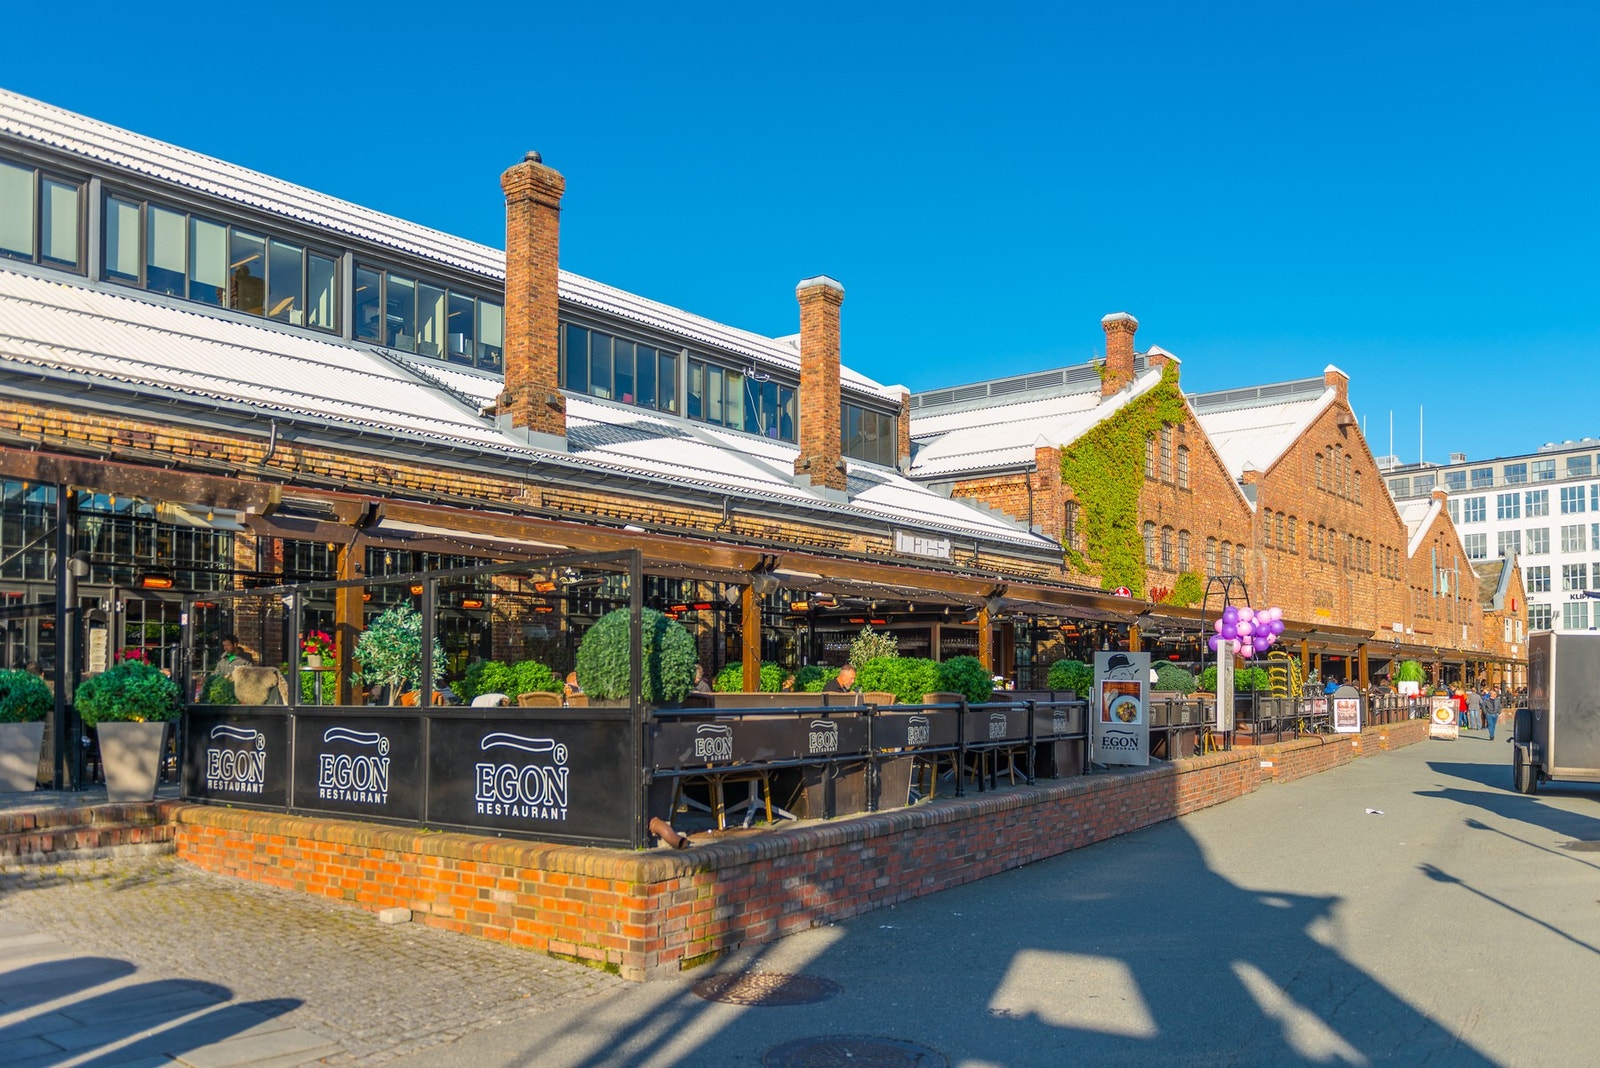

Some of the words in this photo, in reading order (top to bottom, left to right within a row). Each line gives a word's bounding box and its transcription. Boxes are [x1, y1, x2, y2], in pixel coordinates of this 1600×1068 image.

[695, 737, 732, 757] EGON
[809, 731, 838, 749] EGON
[1102, 736, 1138, 747] EGON
[207, 749, 266, 783] EGON
[319, 754, 390, 793] EGON
[208, 780, 264, 794] RESTAURANT
[475, 763, 569, 807] EGON
[319, 788, 388, 804] RESTAURANT
[477, 802, 567, 820] RESTAURANT
